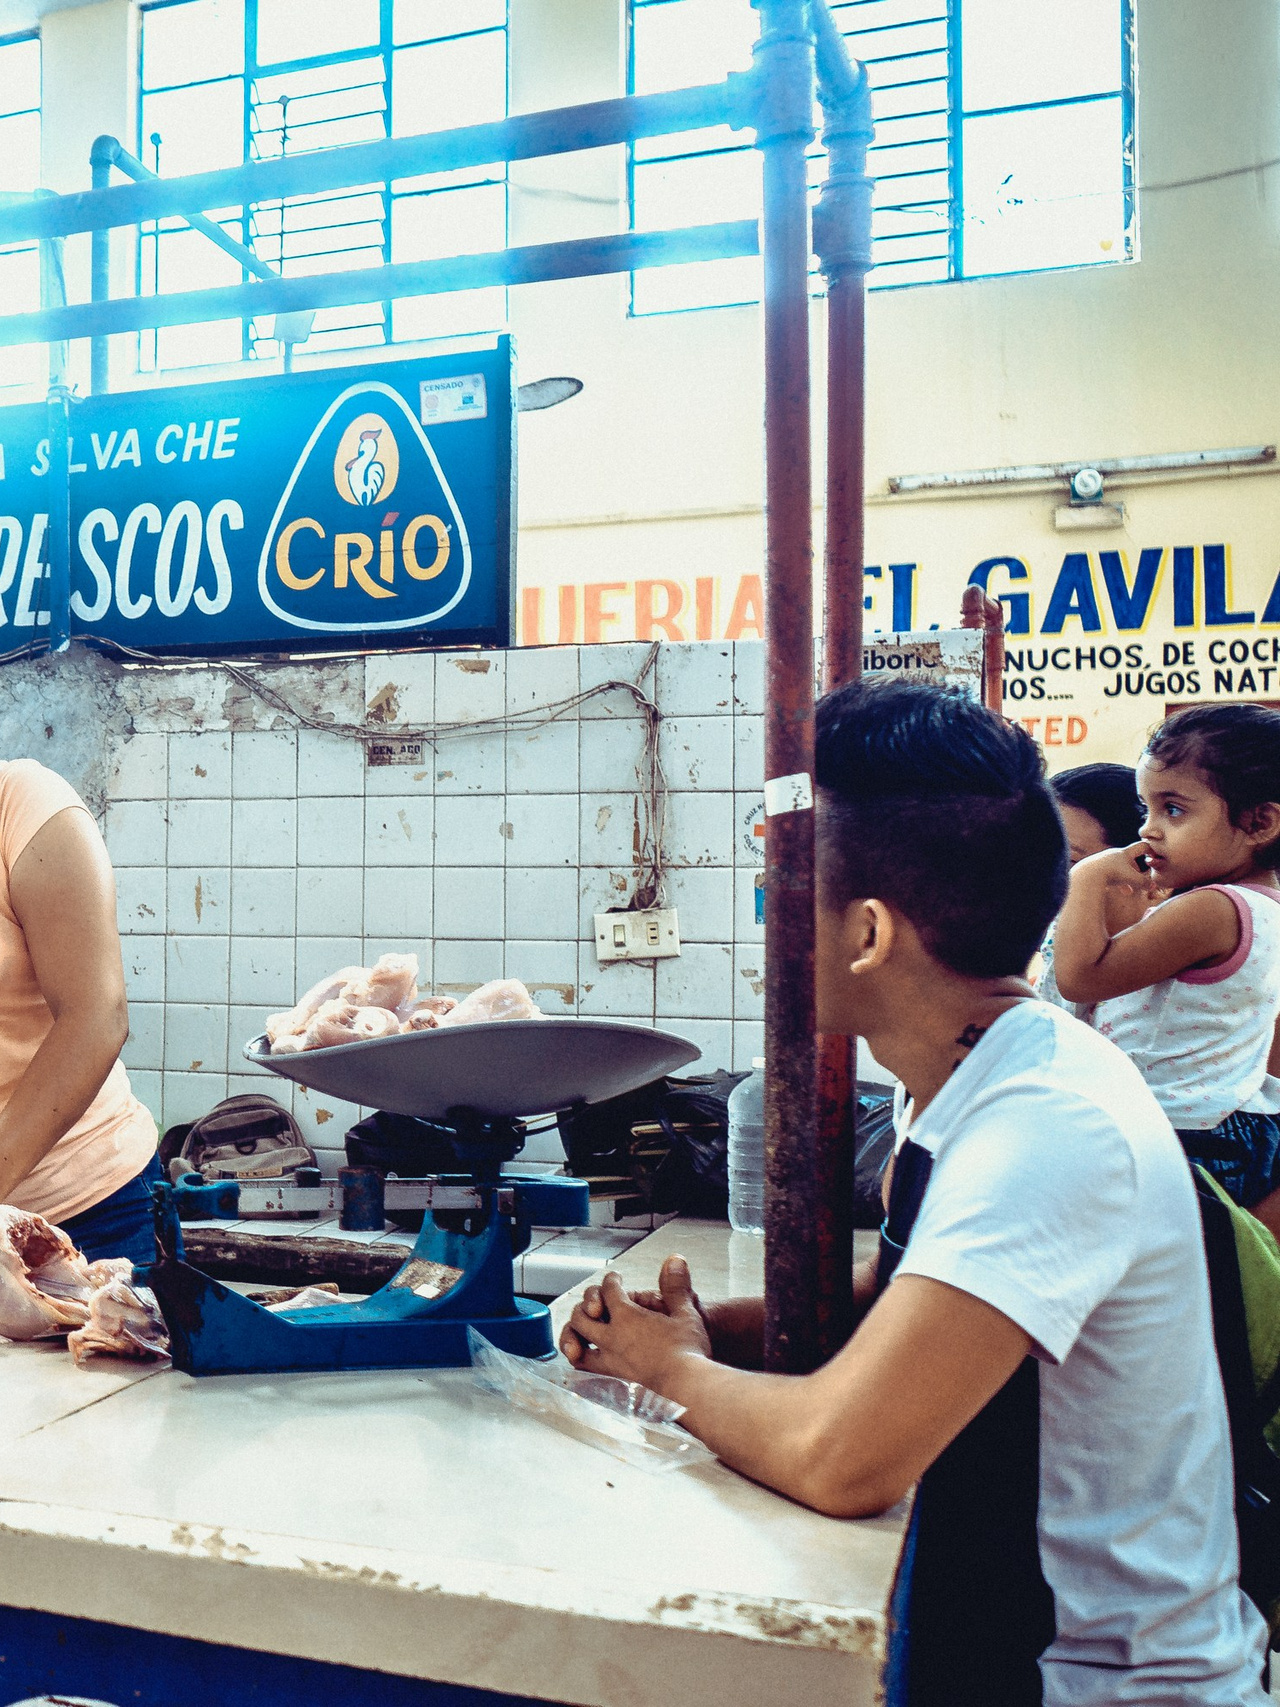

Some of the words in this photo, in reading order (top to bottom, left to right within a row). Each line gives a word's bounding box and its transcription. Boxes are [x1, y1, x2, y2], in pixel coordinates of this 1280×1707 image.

[424, 381, 464, 393] CENSADO
[30, 428, 142, 477] SLVA
[155, 417, 241, 464] CHE
[275, 511, 451, 599] CRÍO
[1163, 640, 1196, 667] DE
[1103, 668, 1202, 698] JUGOS
[1214, 666, 1280, 695] NAT
[744, 807, 759, 826] CRUZ
[743, 833, 766, 858] COLECT
